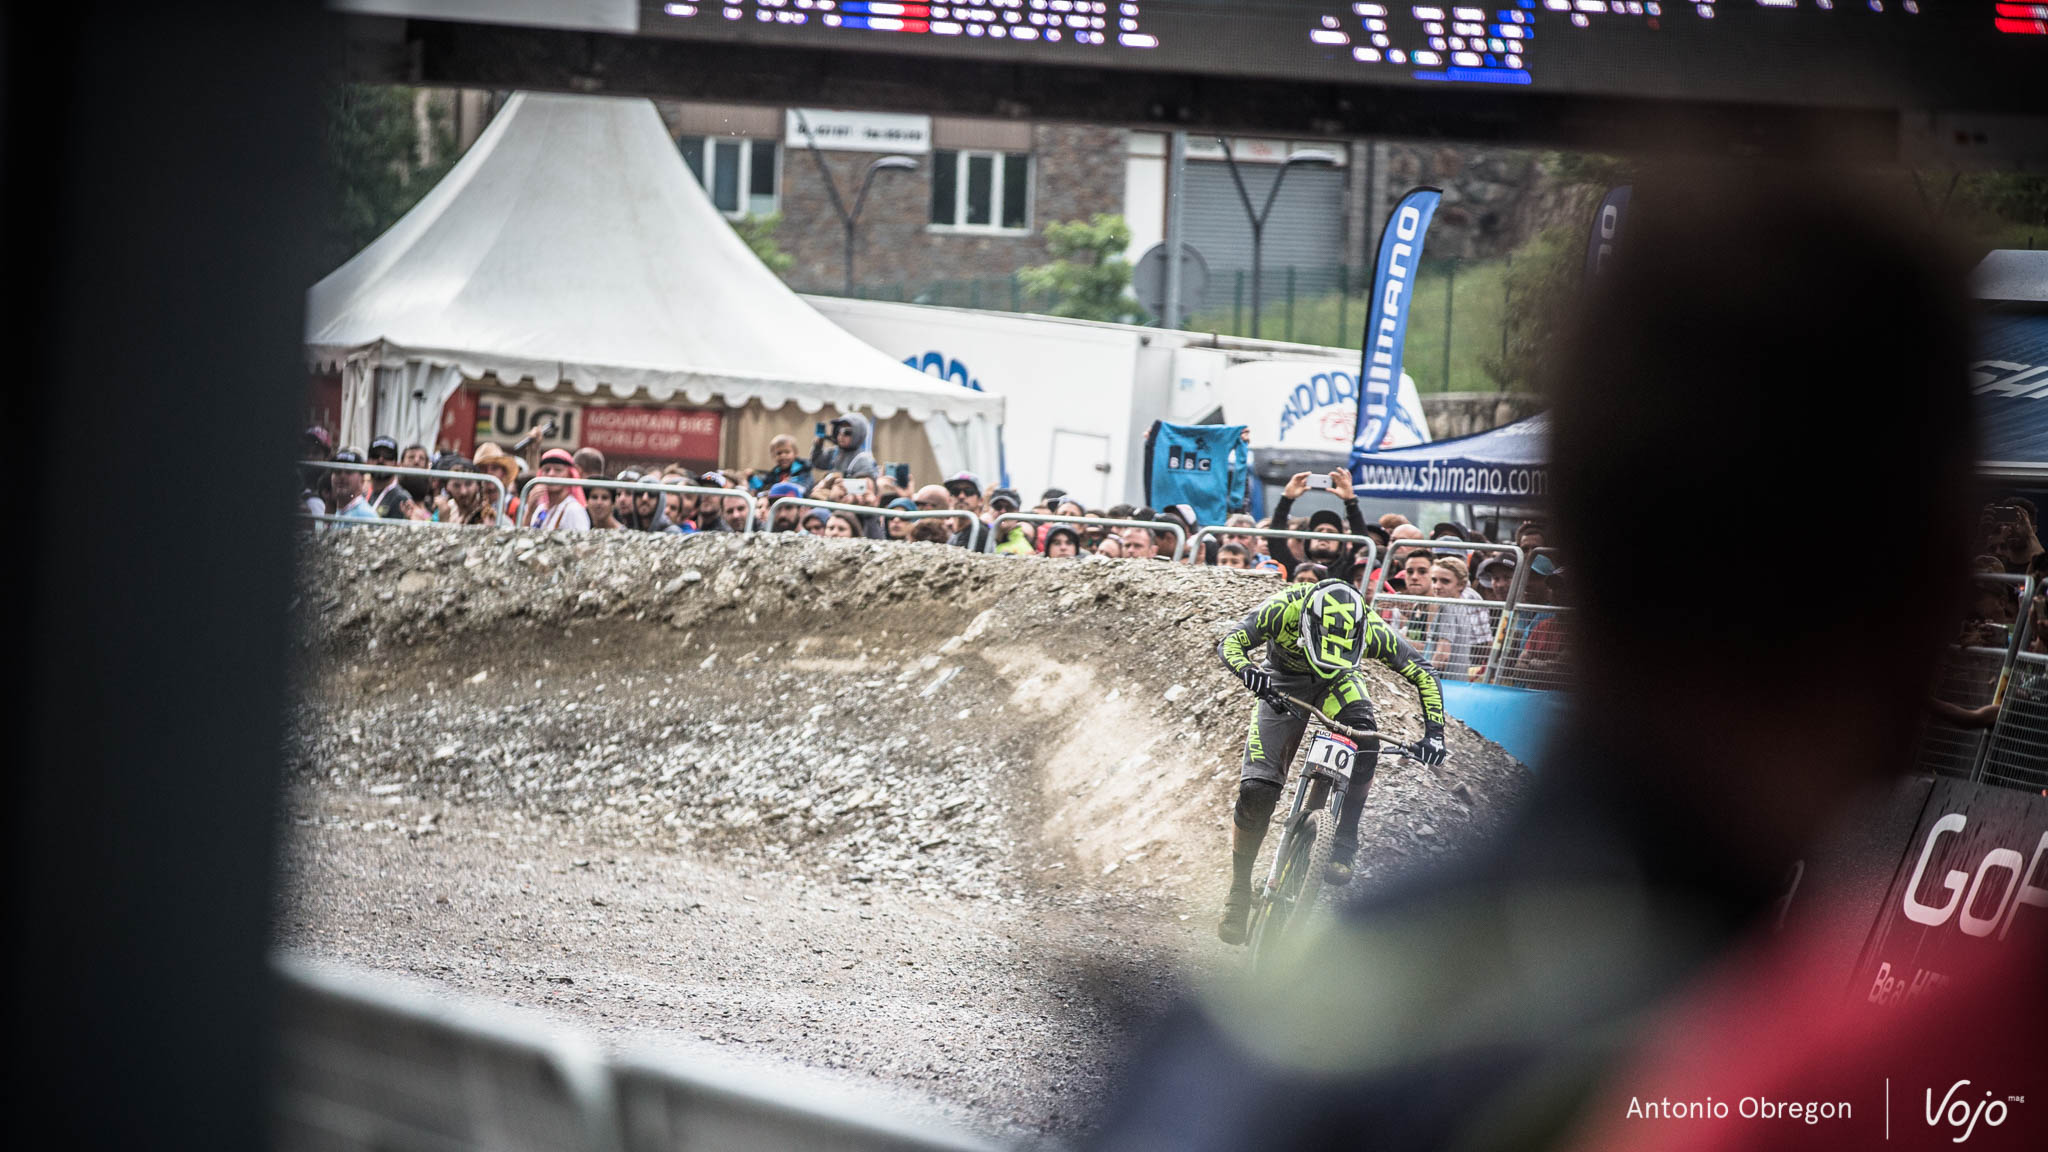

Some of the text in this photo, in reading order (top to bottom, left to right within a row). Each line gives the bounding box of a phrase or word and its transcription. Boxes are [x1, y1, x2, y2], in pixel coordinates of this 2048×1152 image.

[1354, 205, 1420, 450] SHIMANO
[587, 410, 715, 435] MOUNTAIN BIKE
[587, 429, 683, 450] WORLD CUP
[1169, 456, 1211, 471] BBC
[1362, 458, 1550, 496] www.shimano.com
[1323, 744, 1350, 770] 10
[1868, 961, 1895, 1006] Be
